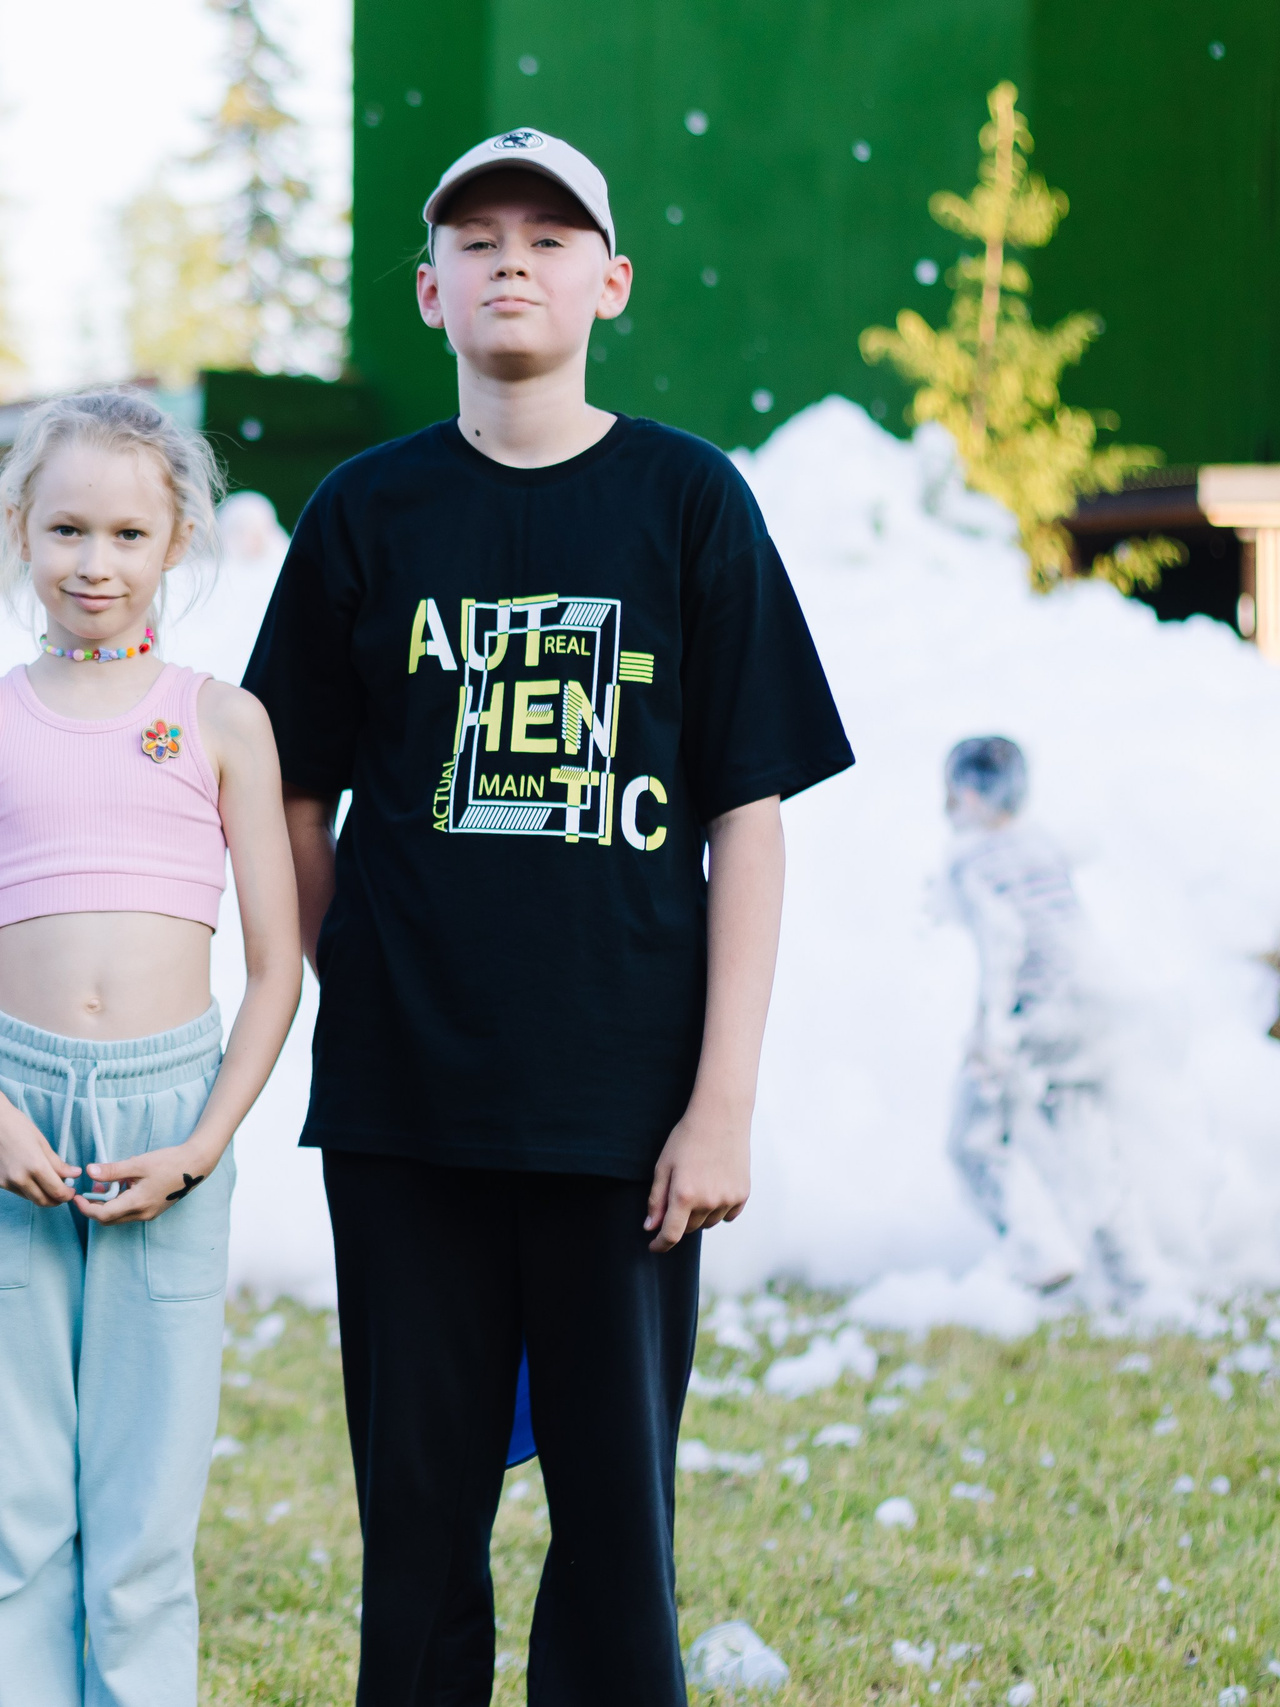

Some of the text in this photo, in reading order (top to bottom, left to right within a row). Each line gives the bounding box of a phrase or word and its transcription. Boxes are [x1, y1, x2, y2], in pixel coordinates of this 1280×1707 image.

[544, 635, 591, 656] REAL
[432, 754, 456, 833] ACTUAL
[478, 774, 545, 798] MAIN
